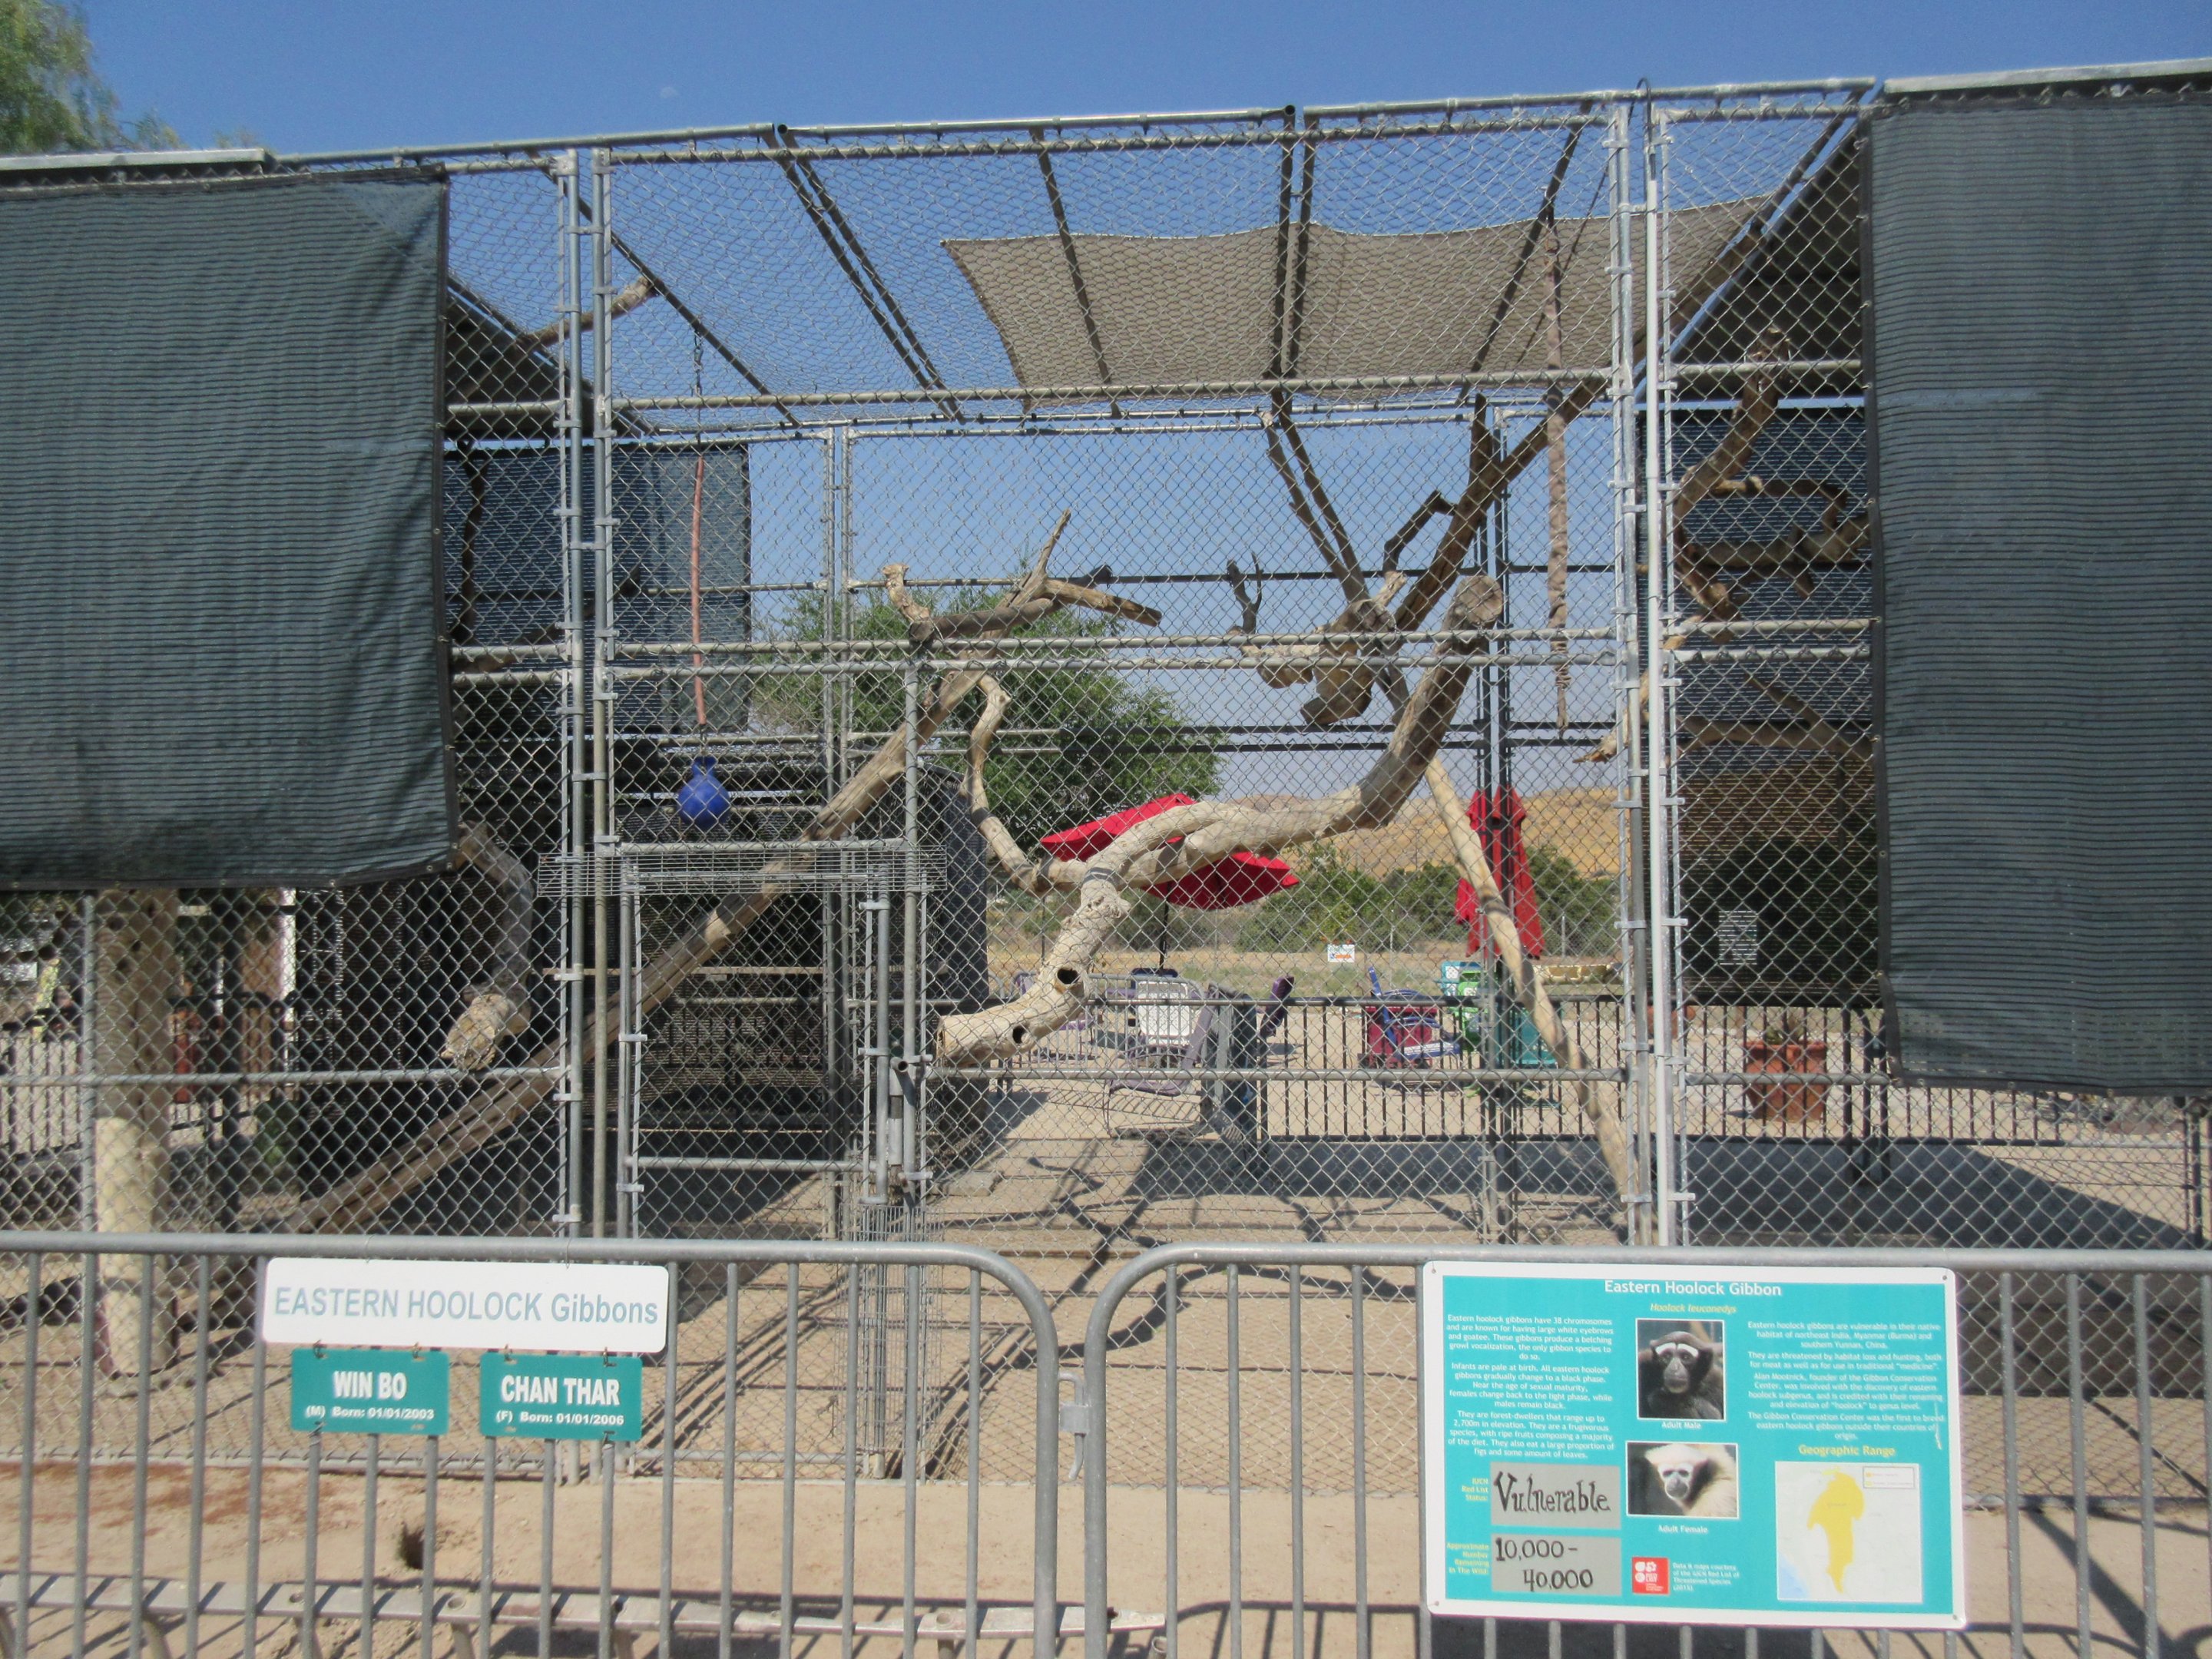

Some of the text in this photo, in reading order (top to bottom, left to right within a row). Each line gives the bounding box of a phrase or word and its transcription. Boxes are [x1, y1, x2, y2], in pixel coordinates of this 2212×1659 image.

[1604, 1280, 1782, 1295] Eastern Hoolock Gibbon
[275, 1286, 657, 1324] EASTERN HOOLOCK Gibbons
[1650, 1303, 1737, 1314] Hoolock leuconedys
[1505, 1316, 1532, 1325] gibbons
[1563, 1317, 1612, 1326] chromosomes
[1512, 1325, 1536, 1334] having
[1538, 1326, 1555, 1334] large
[1579, 1326, 1613, 1336] eyebrows
[1463, 1333, 1488, 1342] goatee.
[1516, 1334, 1542, 1343] gibbons
[1544, 1335, 1573, 1344] produce
[1581, 1336, 1612, 1345] belching
[1449, 1342, 1469, 1351] growl
[1472, 1343, 1515, 1351] vocalization,
[1532, 1343, 1547, 1353] only
[1549, 1344, 1573, 1353] gibbon
[1575, 1345, 1601, 1354] species
[1492, 1363, 1507, 1373] pale
[1455, 1372, 1482, 1381] gibbons
[1483, 1373, 1515, 1382] gradually
[1518, 1373, 1543, 1382] change
[1582, 1375, 1605, 1384] phase.
[333, 1371, 406, 1399] WIN BO
[501, 1375, 619, 1406] CHAN THAR
[1555, 1383, 1588, 1392] maturity,
[1479, 1390, 1504, 1399] change
[1548, 1392, 1565, 1401] light
[1567, 1392, 1590, 1402] phase,
[306, 1406, 433, 1419] (M) Born: 01/01/2003
[496, 1410, 624, 1425] (F) Born: 01/01/2006
[1458, 1411, 1475, 1420] They
[1490, 1412, 1544, 1420] forest-dwellers
[1454, 1419, 1479, 1428] 2,700m
[1490, 1420, 1525, 1429] elevation.
[1529, 1422, 1546, 1431] They
[1568, 1423, 1608, 1432] frugivorous
[1450, 1429, 1477, 1438] species,
[1498, 1430, 1512, 1439] ripe
[1535, 1431, 1573, 1441] composing
[1581, 1432, 1613, 1442] majority
[1492, 1439, 1508, 1448] They
[1547, 1441, 1565, 1449] large
[1567, 1442, 1604, 1451] proportion
[1799, 1445, 1895, 1457] Geographic Range
[1474, 1448, 1486, 1457] figs
[1493, 1471, 1611, 1513] Vulnerable
[1657, 1525, 1708, 1534] Adult Female
[1523, 1569, 1593, 1592] 40,000
